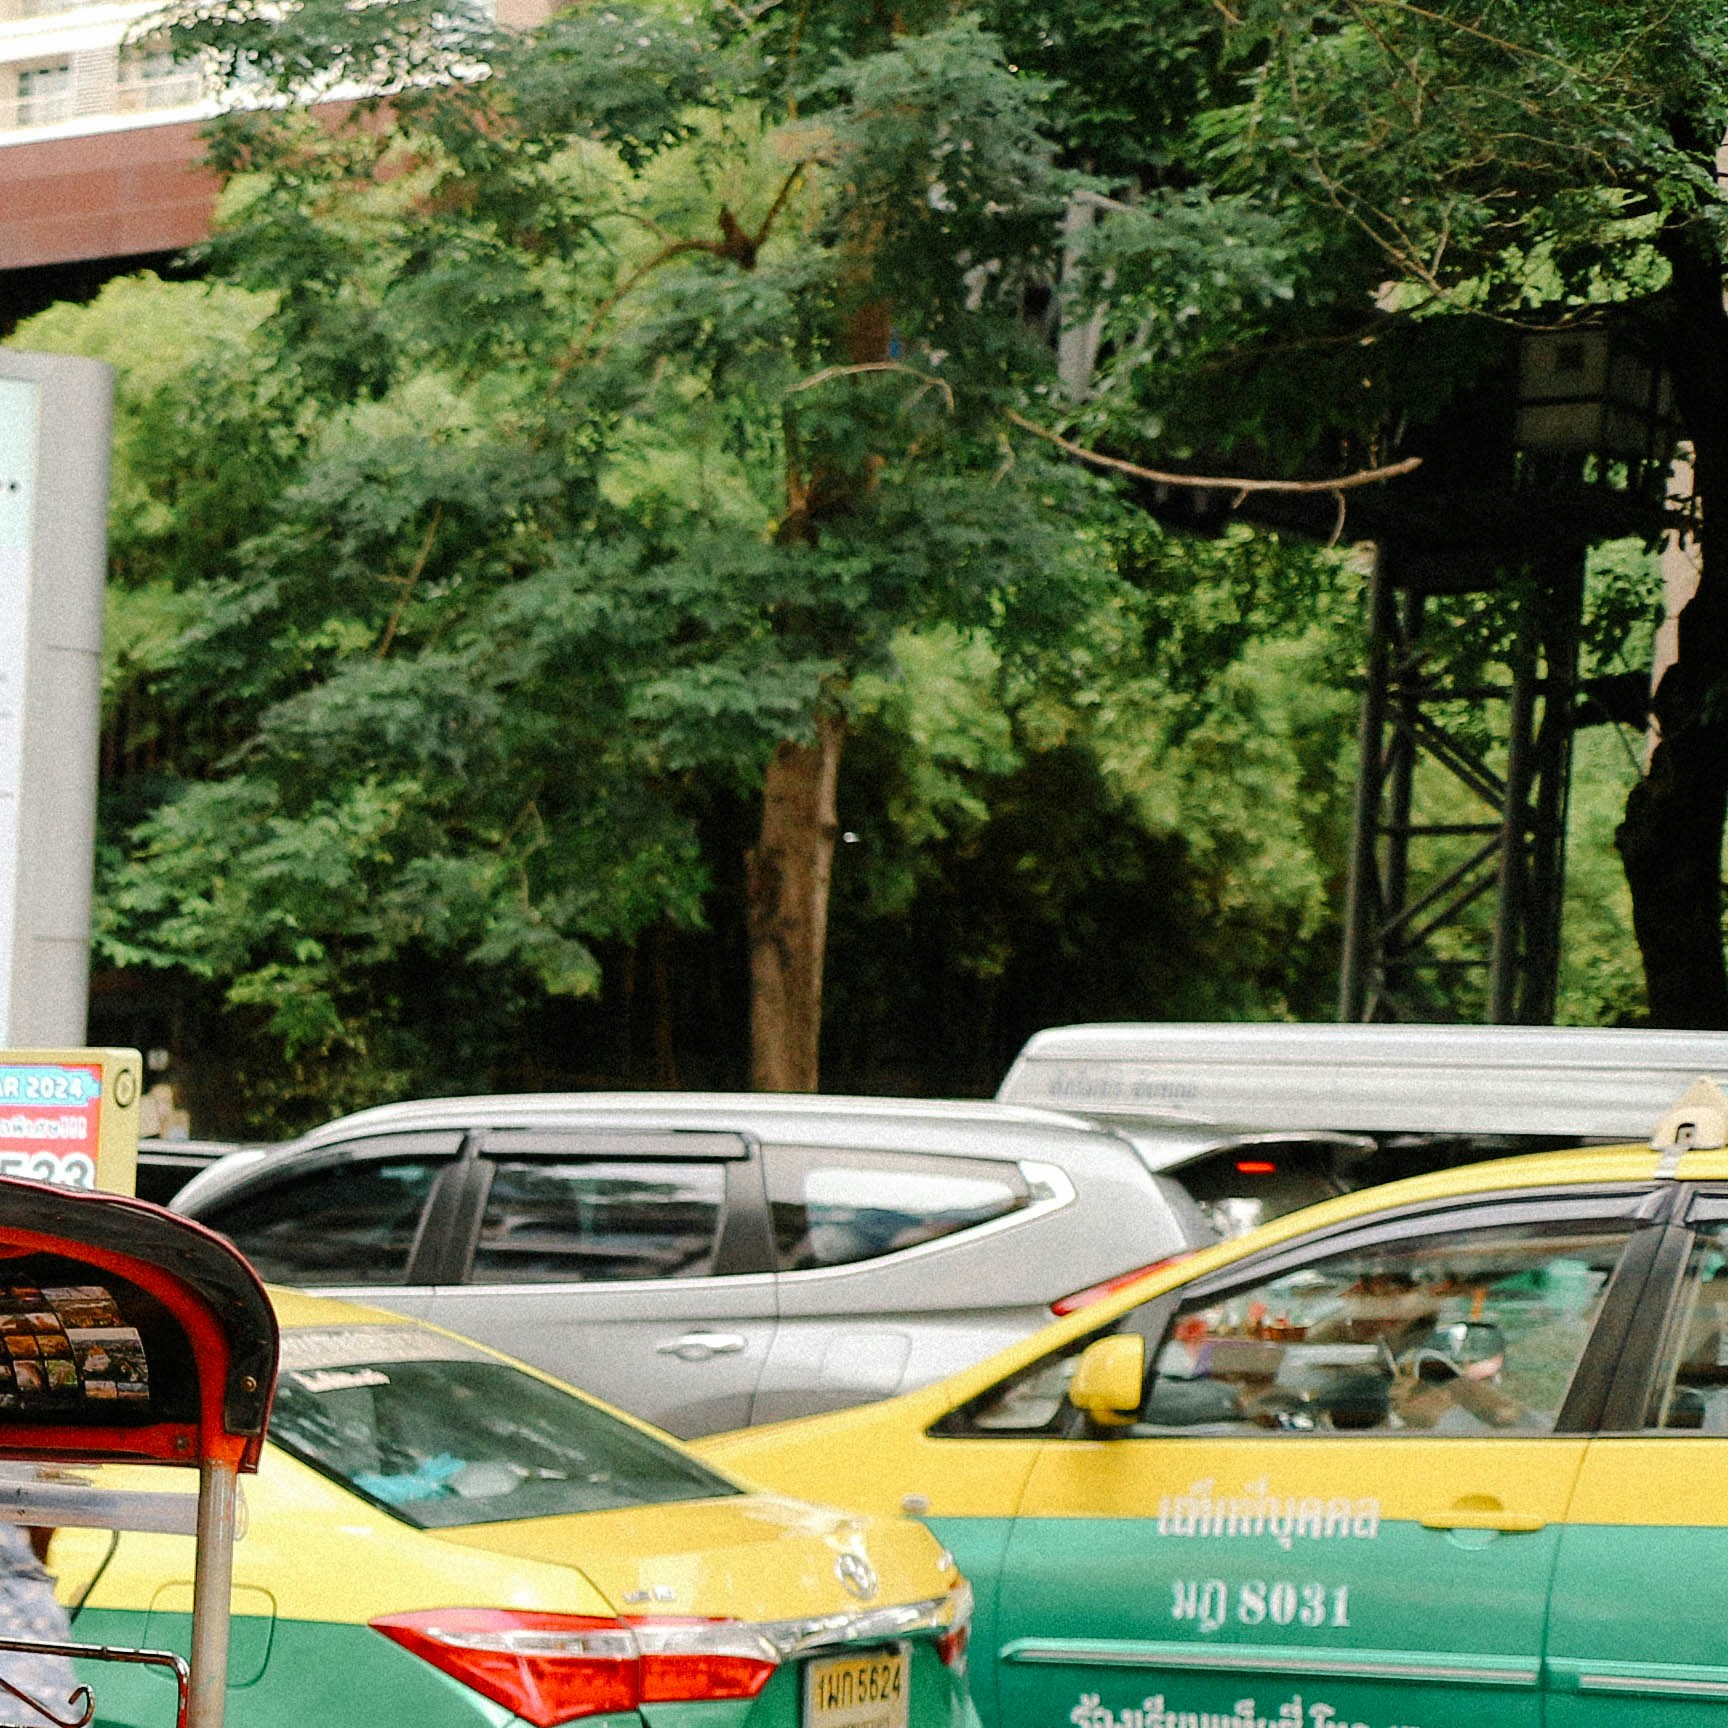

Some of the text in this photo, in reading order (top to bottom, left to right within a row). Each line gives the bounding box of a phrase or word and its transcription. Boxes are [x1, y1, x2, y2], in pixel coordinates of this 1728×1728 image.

[26, 1077, 84, 1099] 2024
[1238, 1578, 1352, 1628] 8031
[858, 1663, 901, 1703] 5624
